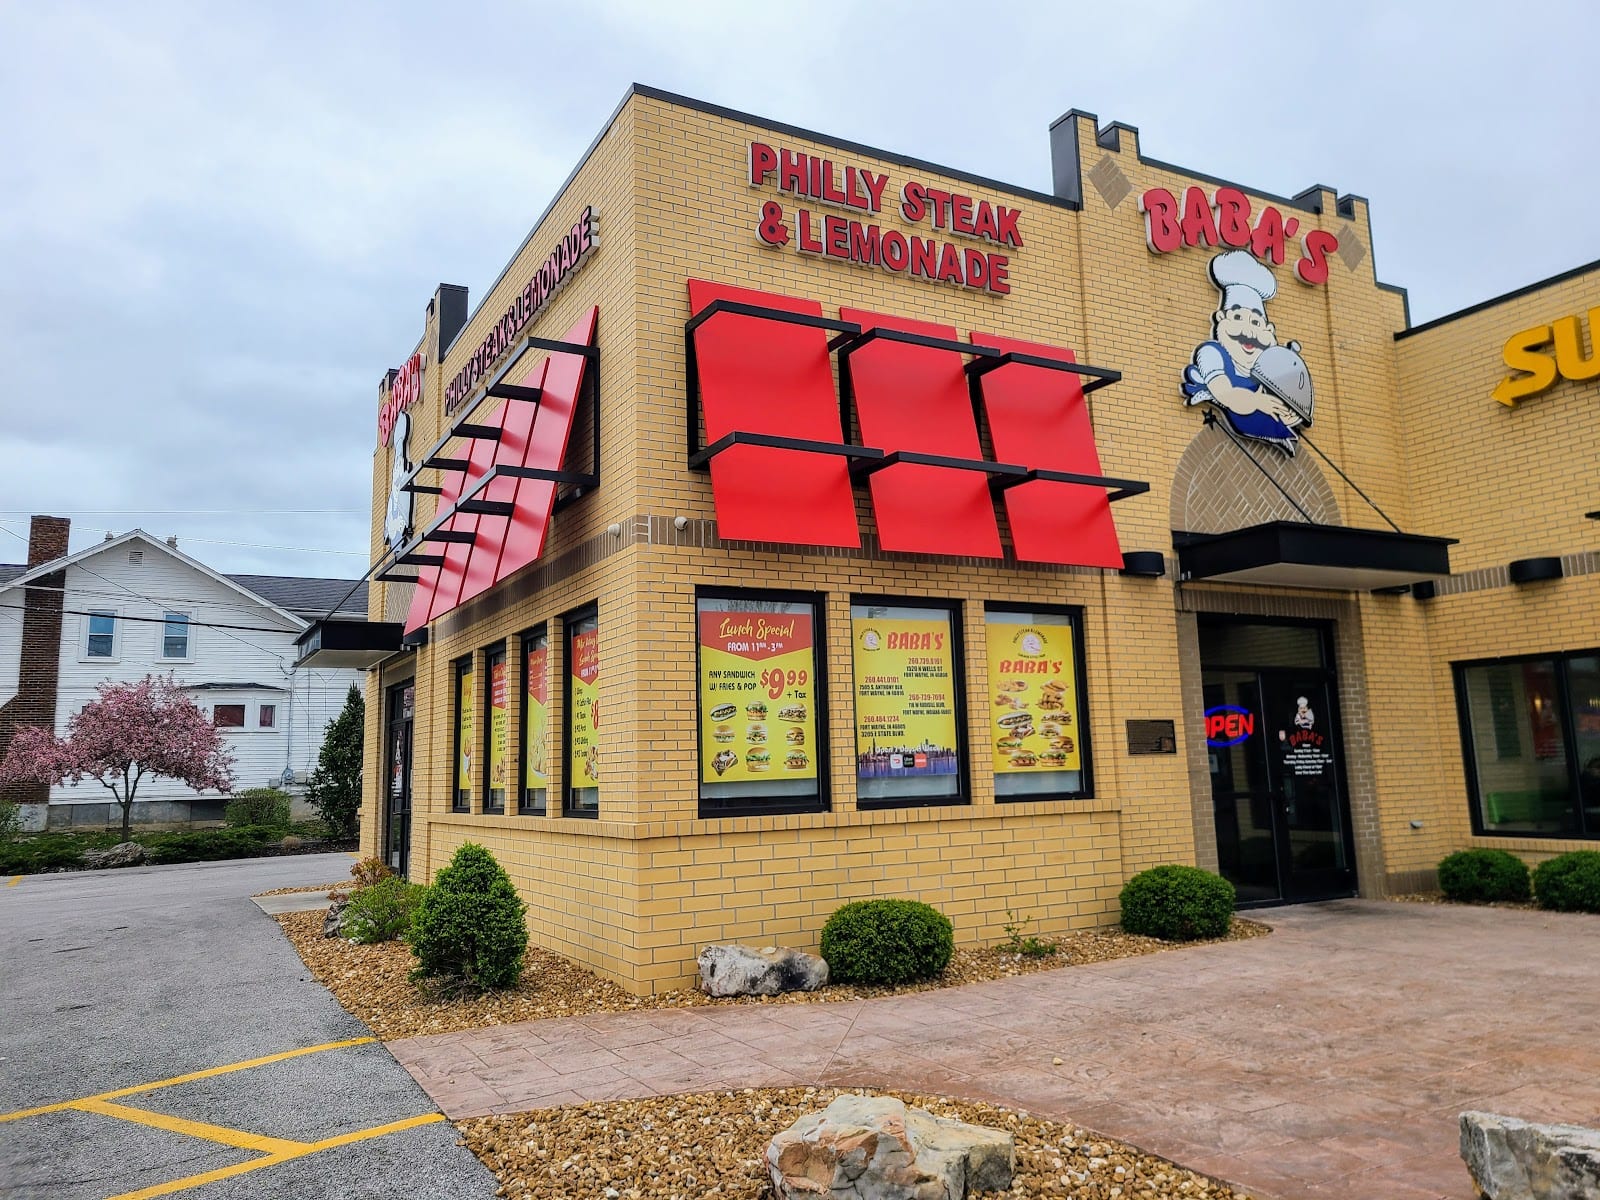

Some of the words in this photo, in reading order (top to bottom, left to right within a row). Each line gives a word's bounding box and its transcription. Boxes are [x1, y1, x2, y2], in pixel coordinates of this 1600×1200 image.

[750, 142, 889, 215] PHILLY
[900, 181, 1024, 248] STEAK
[1139, 186, 1338, 286] BABA'S
[756, 201, 790, 249] &
[797, 209, 1010, 296] LEMONADE
[445, 357, 474, 417] PHILLY
[472, 314, 508, 383] STEAK
[507, 305, 517, 342] &
[516, 205, 598, 332] LEMONADE
[720, 618, 752, 638] Lunch
[756, 618, 794, 640] Special
[728, 642, 749, 652] FROM
[888, 632, 944, 650] BABA'S
[709, 670, 722, 678] ANY
[723, 670, 756, 679] SANDWICH
[1000, 660, 1062, 674] BABA'S
[794, 690, 806, 698] Tax
